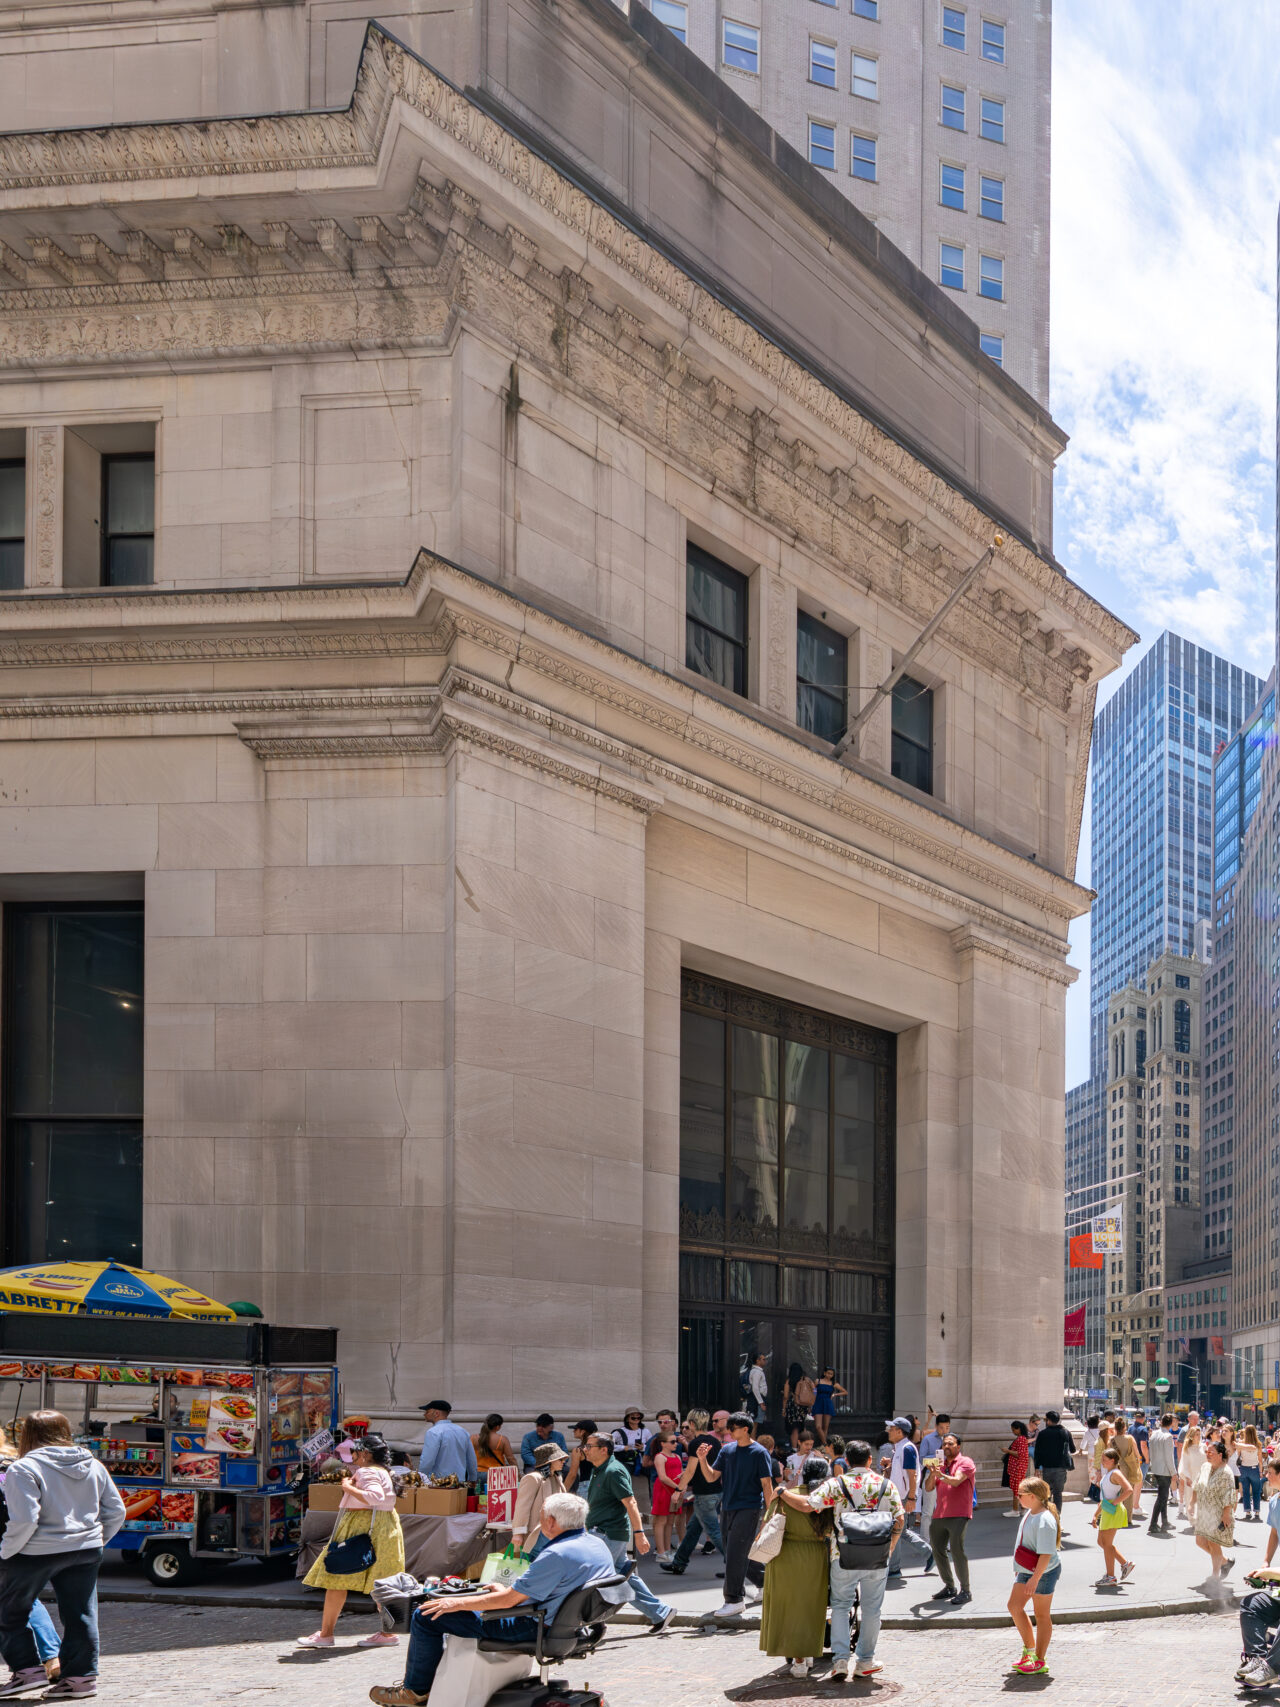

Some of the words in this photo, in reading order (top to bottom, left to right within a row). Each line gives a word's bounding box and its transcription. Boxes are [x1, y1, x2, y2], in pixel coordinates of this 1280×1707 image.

[283, 1419, 291, 1429] A
[319, 1432, 333, 1447] MOM
[488, 1468, 517, 1489] KEYCHAIN
